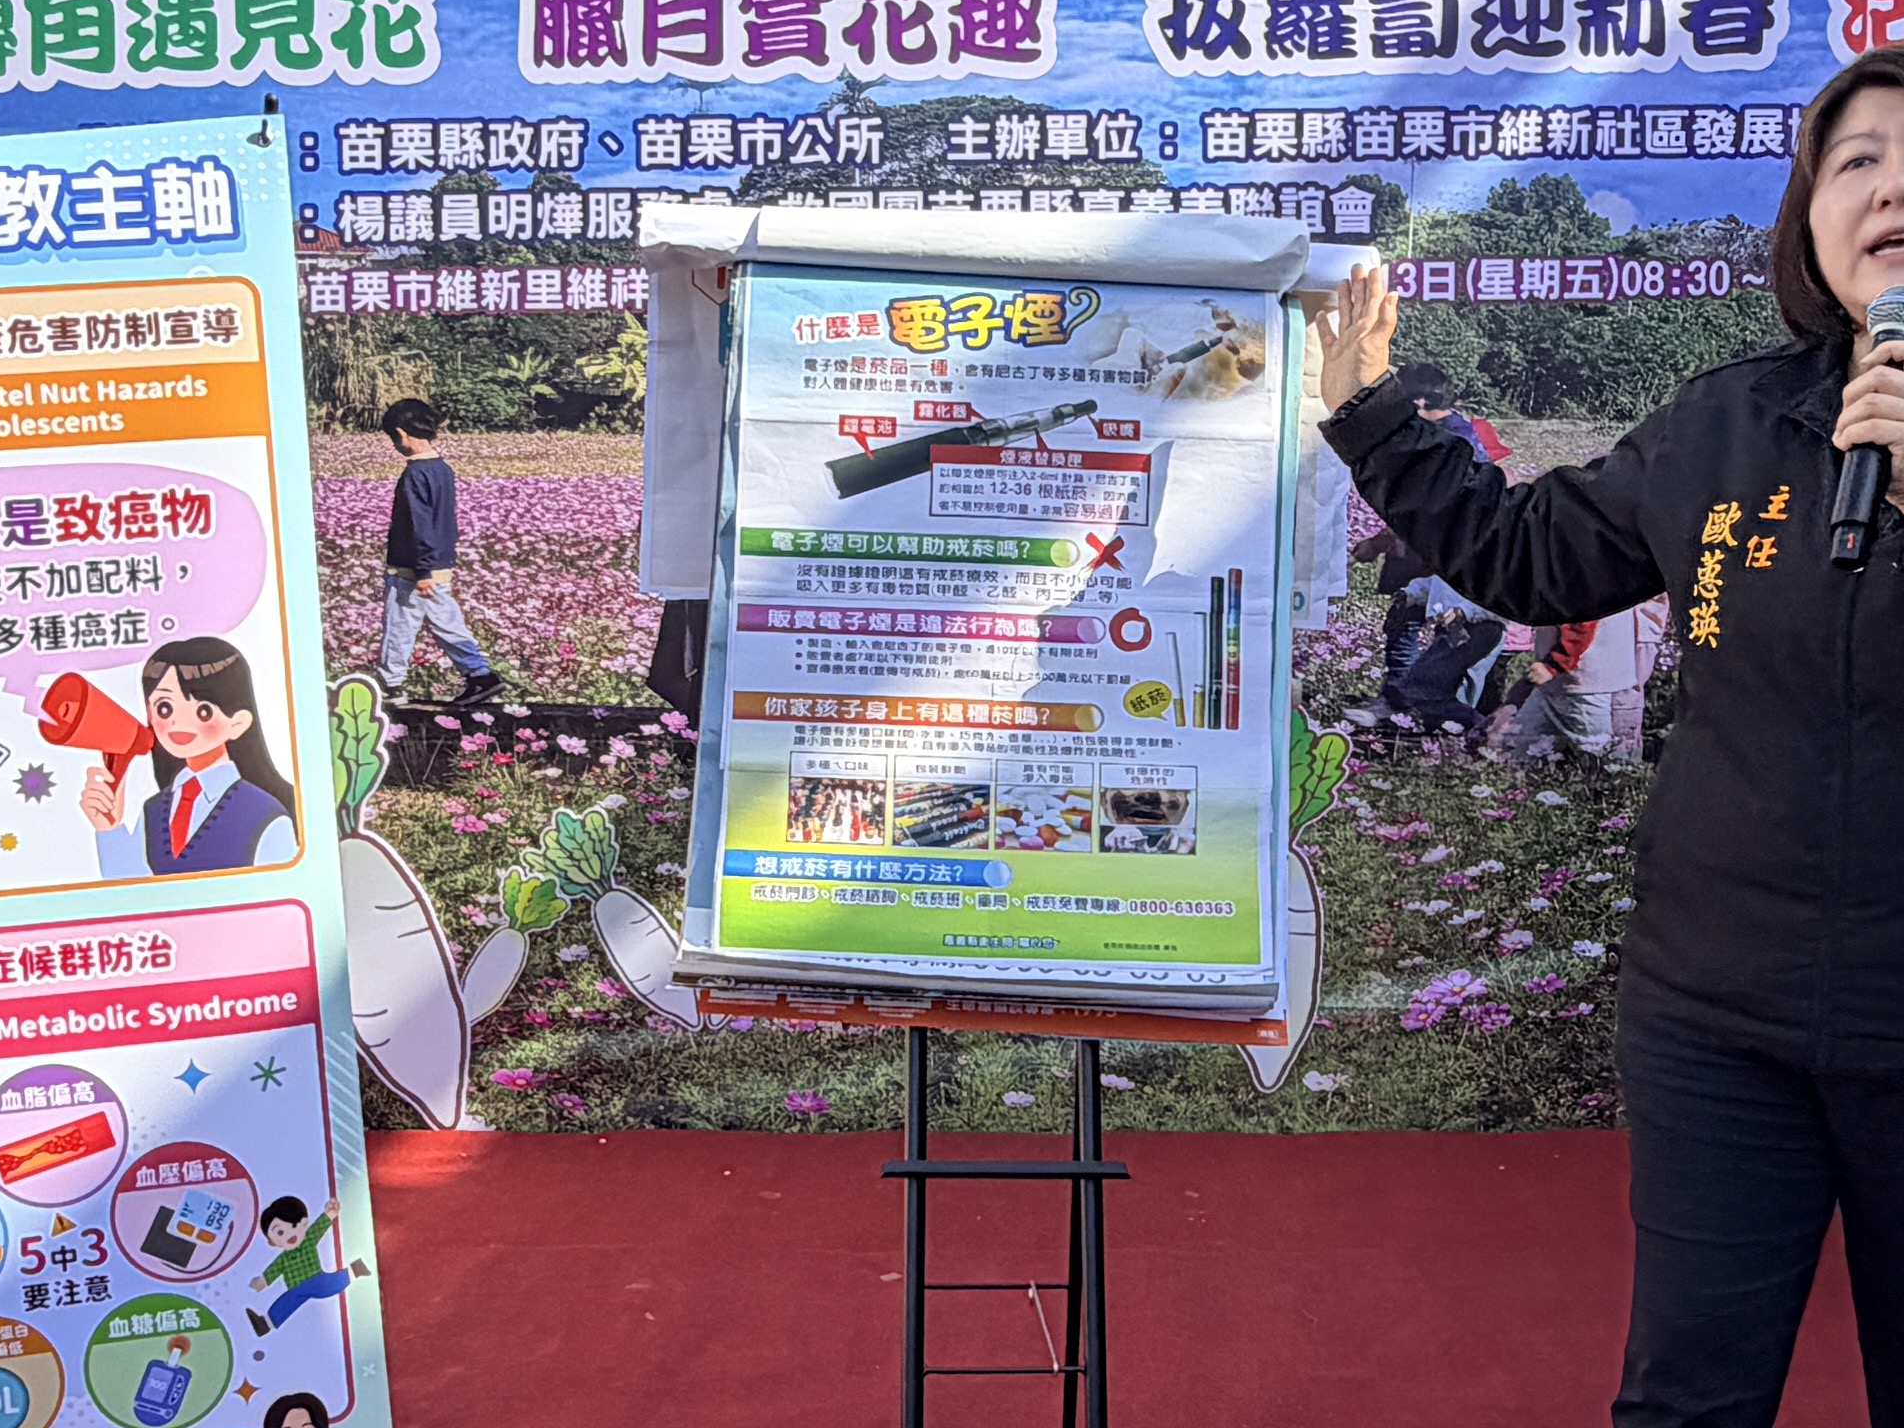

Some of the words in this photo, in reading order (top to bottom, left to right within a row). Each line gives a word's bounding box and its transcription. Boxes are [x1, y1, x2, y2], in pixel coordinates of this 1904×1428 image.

[947, 107, 1800, 162] 主辦單位：苗栗縣苗栗市維新社區發展
[41, 381, 91, 405] Nut
[97, 375, 207, 401] Hazards
[990, 481, 1033, 497] 12-36
[1745, 485, 1791, 569] 主任
[149, 991, 298, 1027] Syndrome
[0, 1081, 96, 1112] 血脂偏高
[134, 1158, 228, 1188] 血壓偏高
[19, 1227, 109, 1276] 5中3
[21, 1275, 114, 1313] 要注意
[107, 1307, 202, 1339] 血糖偏高
